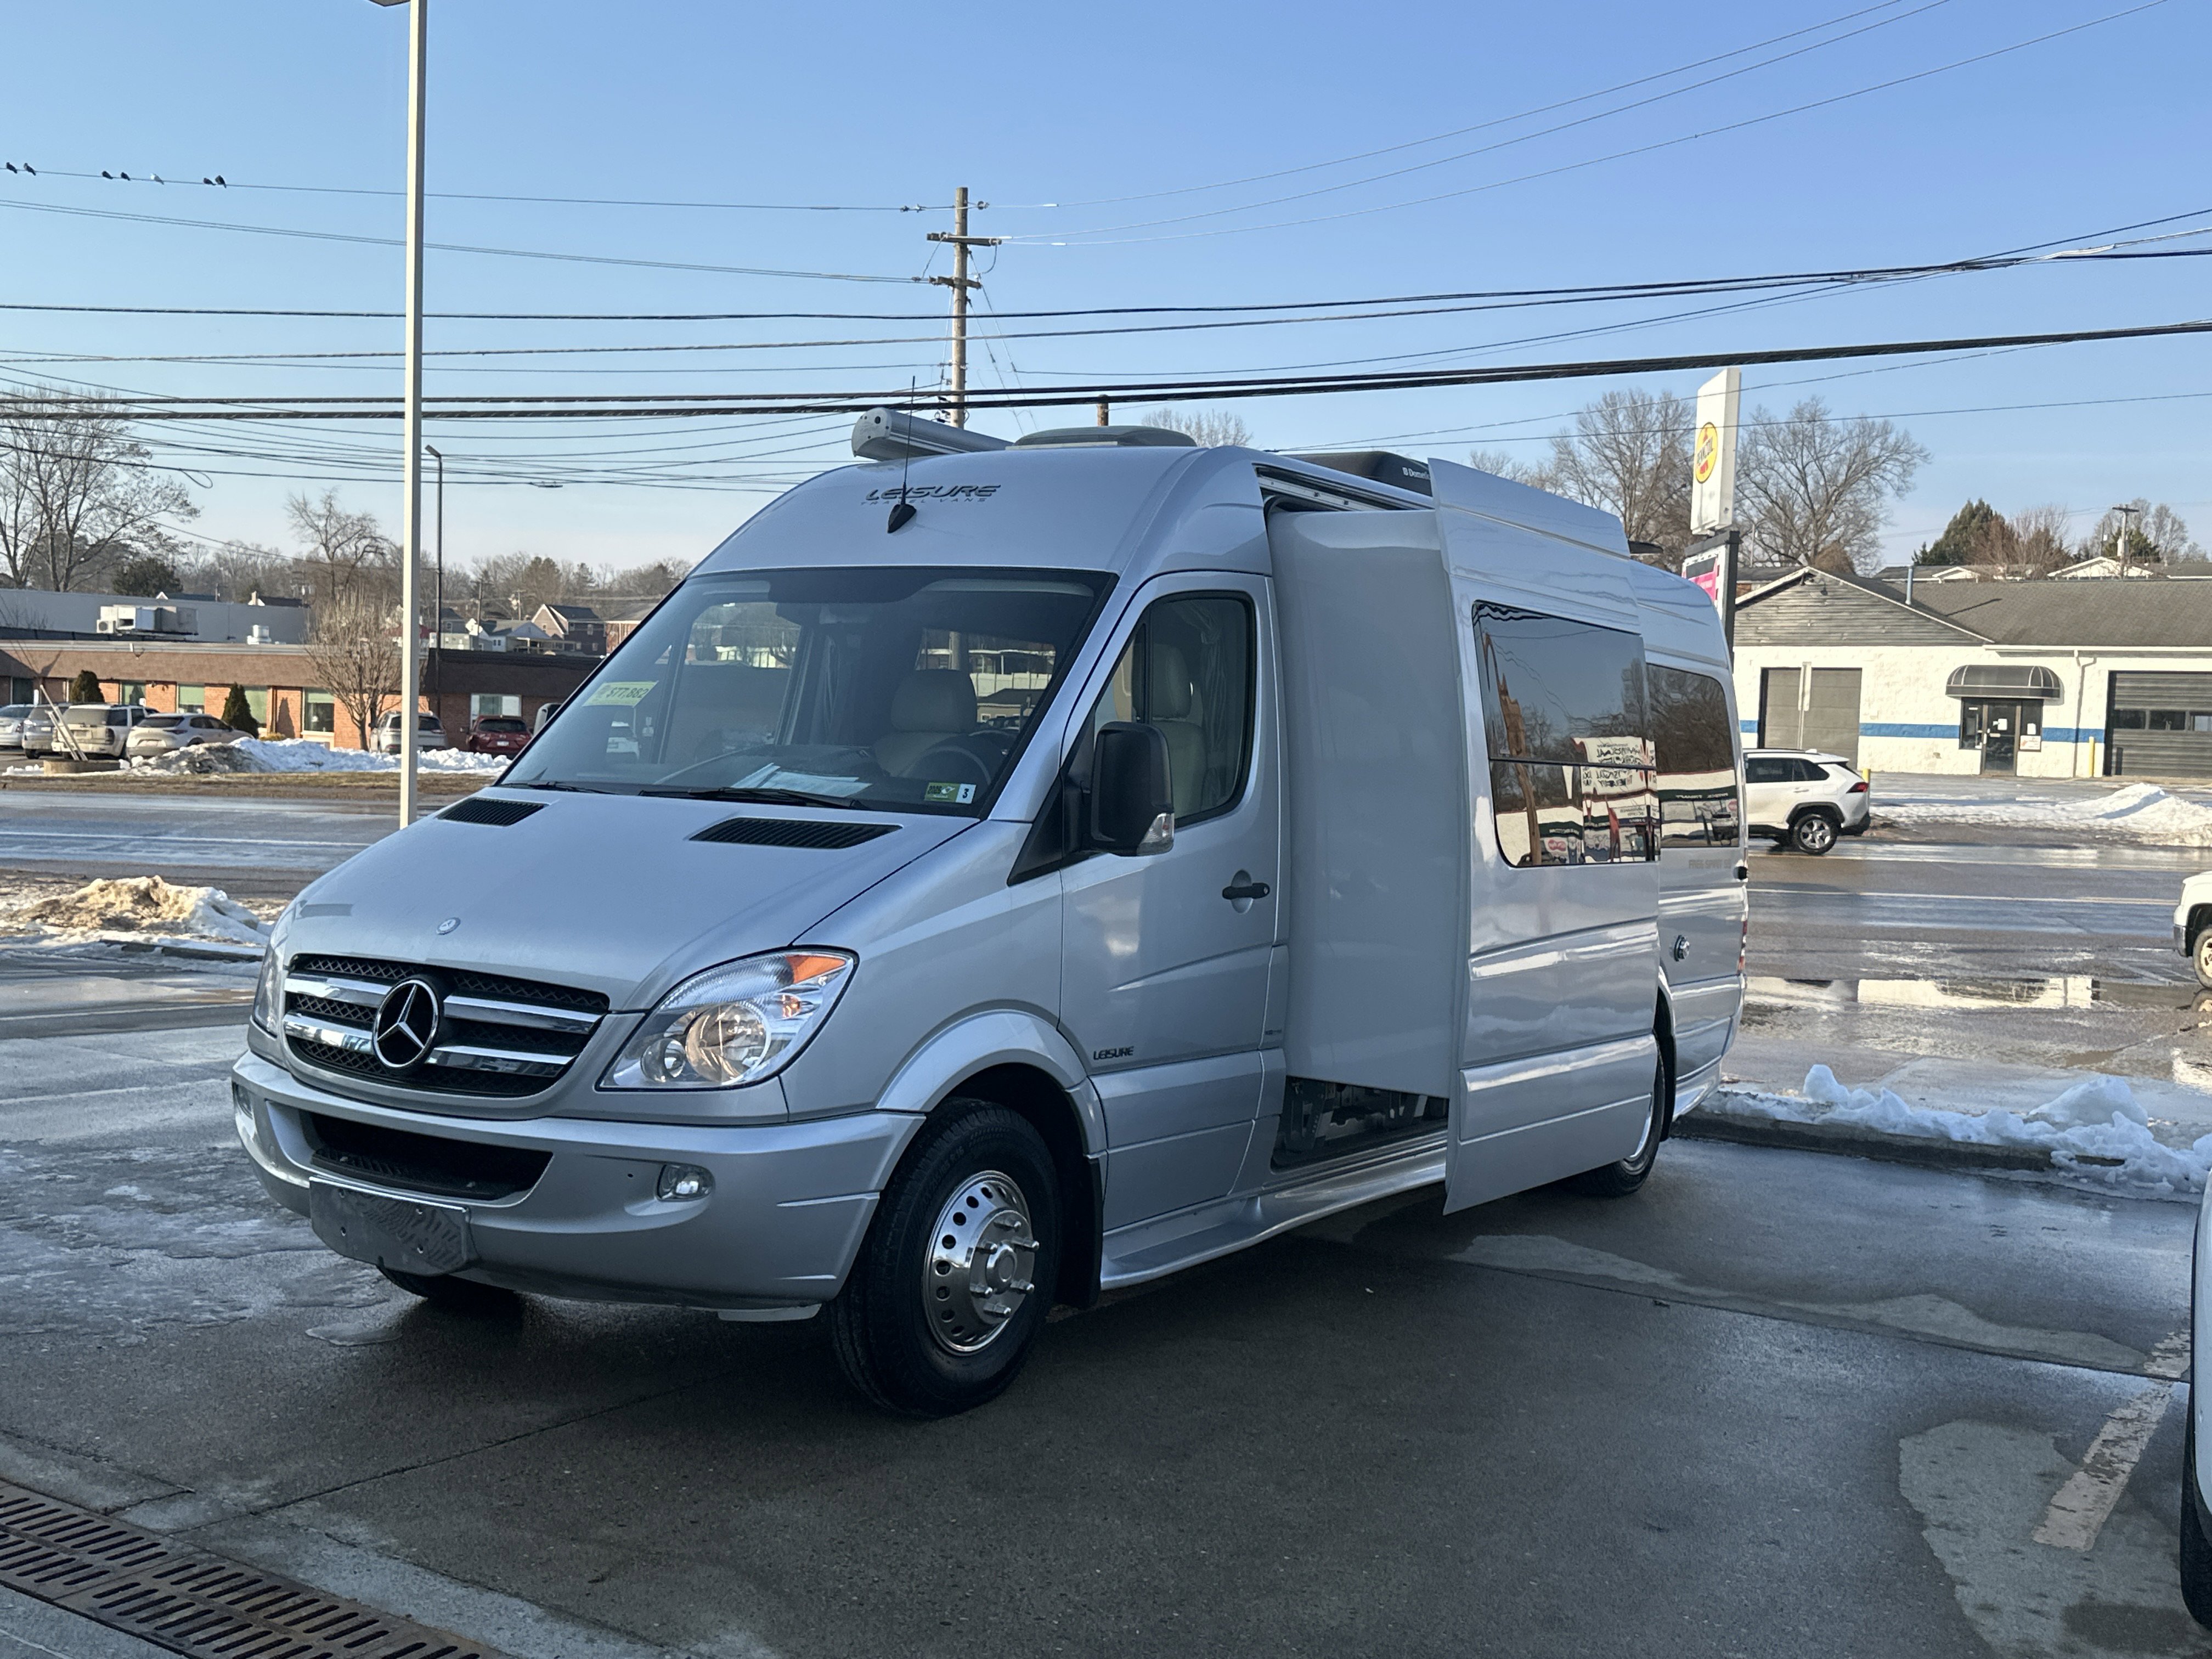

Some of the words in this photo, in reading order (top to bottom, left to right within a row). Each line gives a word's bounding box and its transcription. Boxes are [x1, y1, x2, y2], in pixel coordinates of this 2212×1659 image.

[866, 484, 1001, 500] LEISURE
[606, 687, 649, 699] $77,882
[962, 788, 970, 799] 3
[1093, 1046, 1135, 1060] LEISURE
